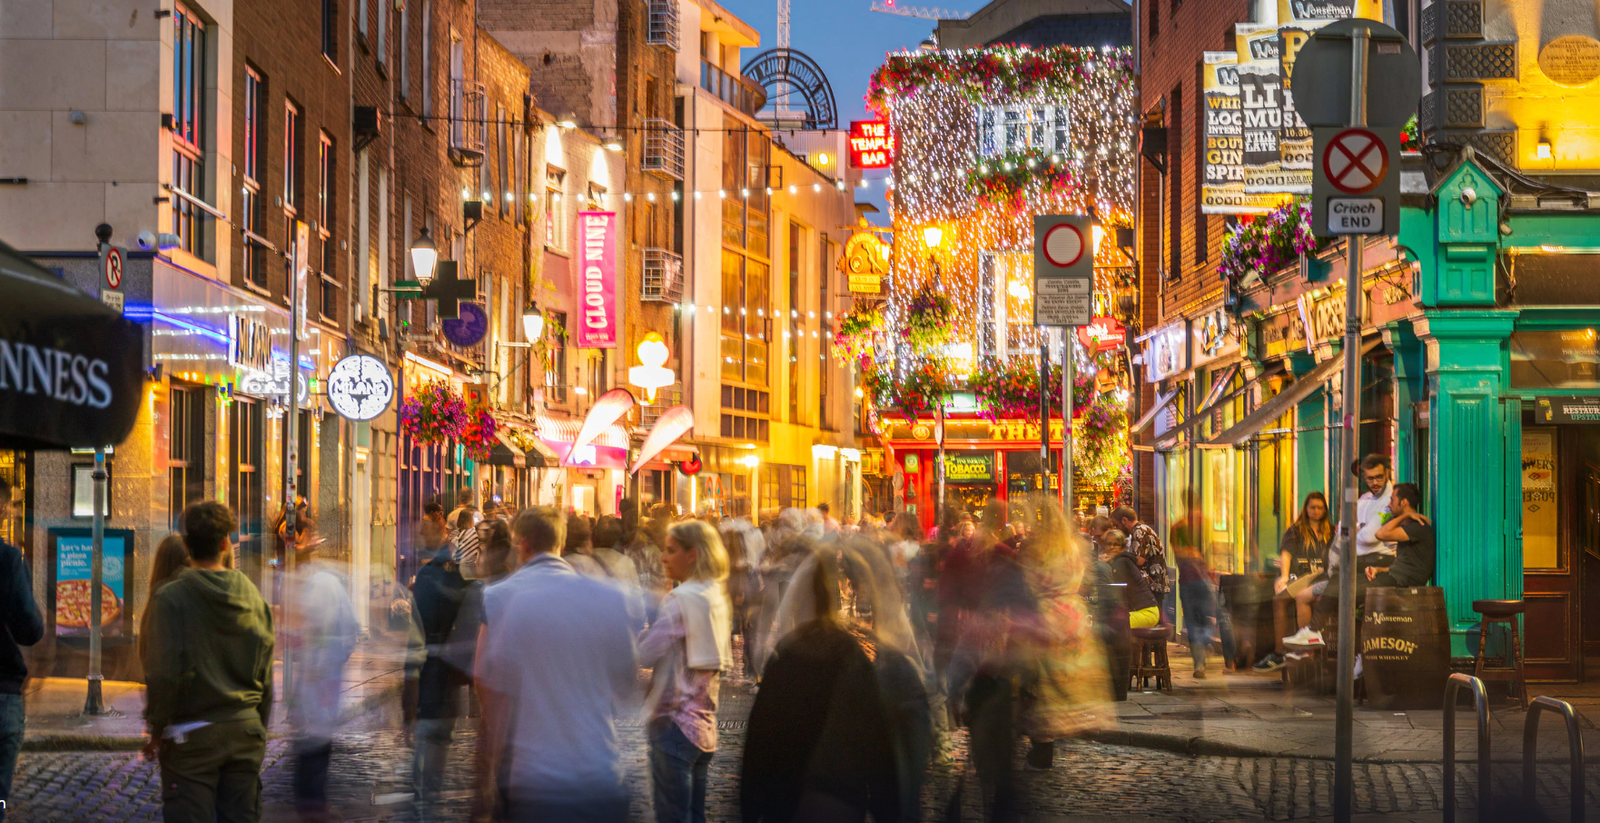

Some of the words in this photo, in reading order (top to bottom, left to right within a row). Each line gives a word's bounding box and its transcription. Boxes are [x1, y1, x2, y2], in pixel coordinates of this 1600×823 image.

[861, 124, 885, 136] THE
[1245, 131, 1275, 141] TILL
[851, 137, 894, 151] TEMPLE
[1246, 142, 1276, 152] LATE
[862, 152, 885, 164] BAR
[1207, 150, 1243, 164] GIN
[1334, 203, 1376, 214] Crioch
[1341, 217, 1371, 227] END
[585, 215, 608, 261] NINE
[585, 265, 608, 328] CLOUD
[989, 424, 1041, 440] THE
[61, 544, 80, 552] Let's
[1363, 637, 1414, 654] JAMESON
